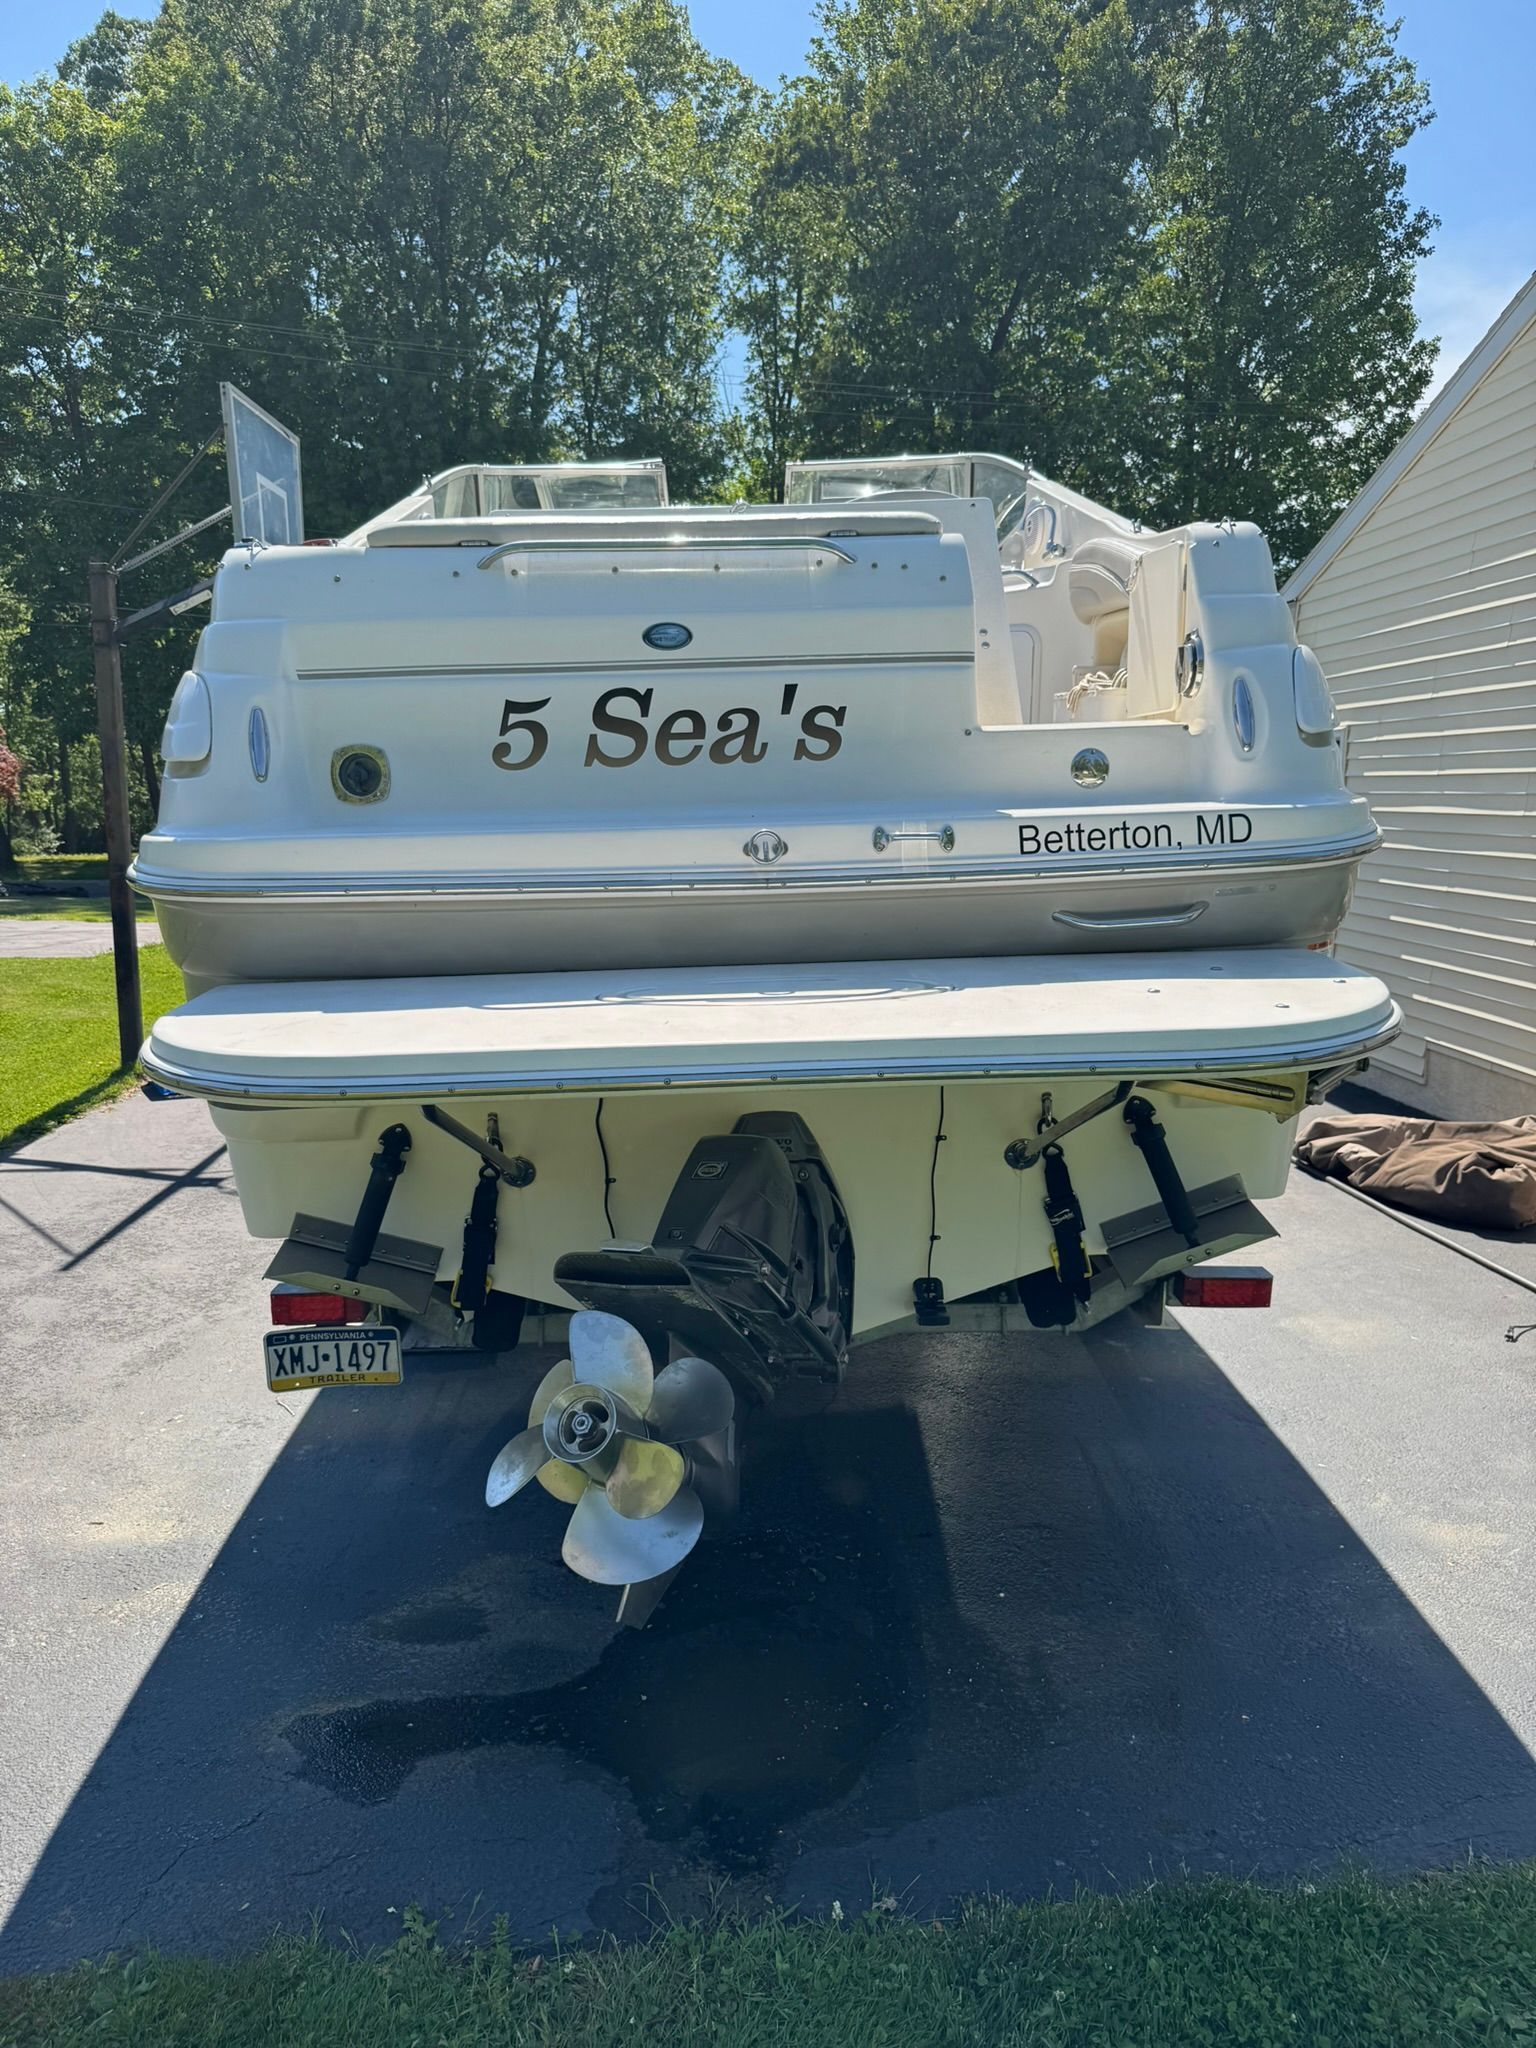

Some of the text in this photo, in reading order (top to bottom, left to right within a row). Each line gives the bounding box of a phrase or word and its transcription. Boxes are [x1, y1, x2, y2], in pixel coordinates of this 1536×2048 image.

[492, 683, 847, 771] 5 Sea's
[1018, 812, 1253, 856] Betterton, MD
[299, 1332, 367, 1341] PENNSYLVANIA
[309, 1374, 366, 1384] TRAILER
